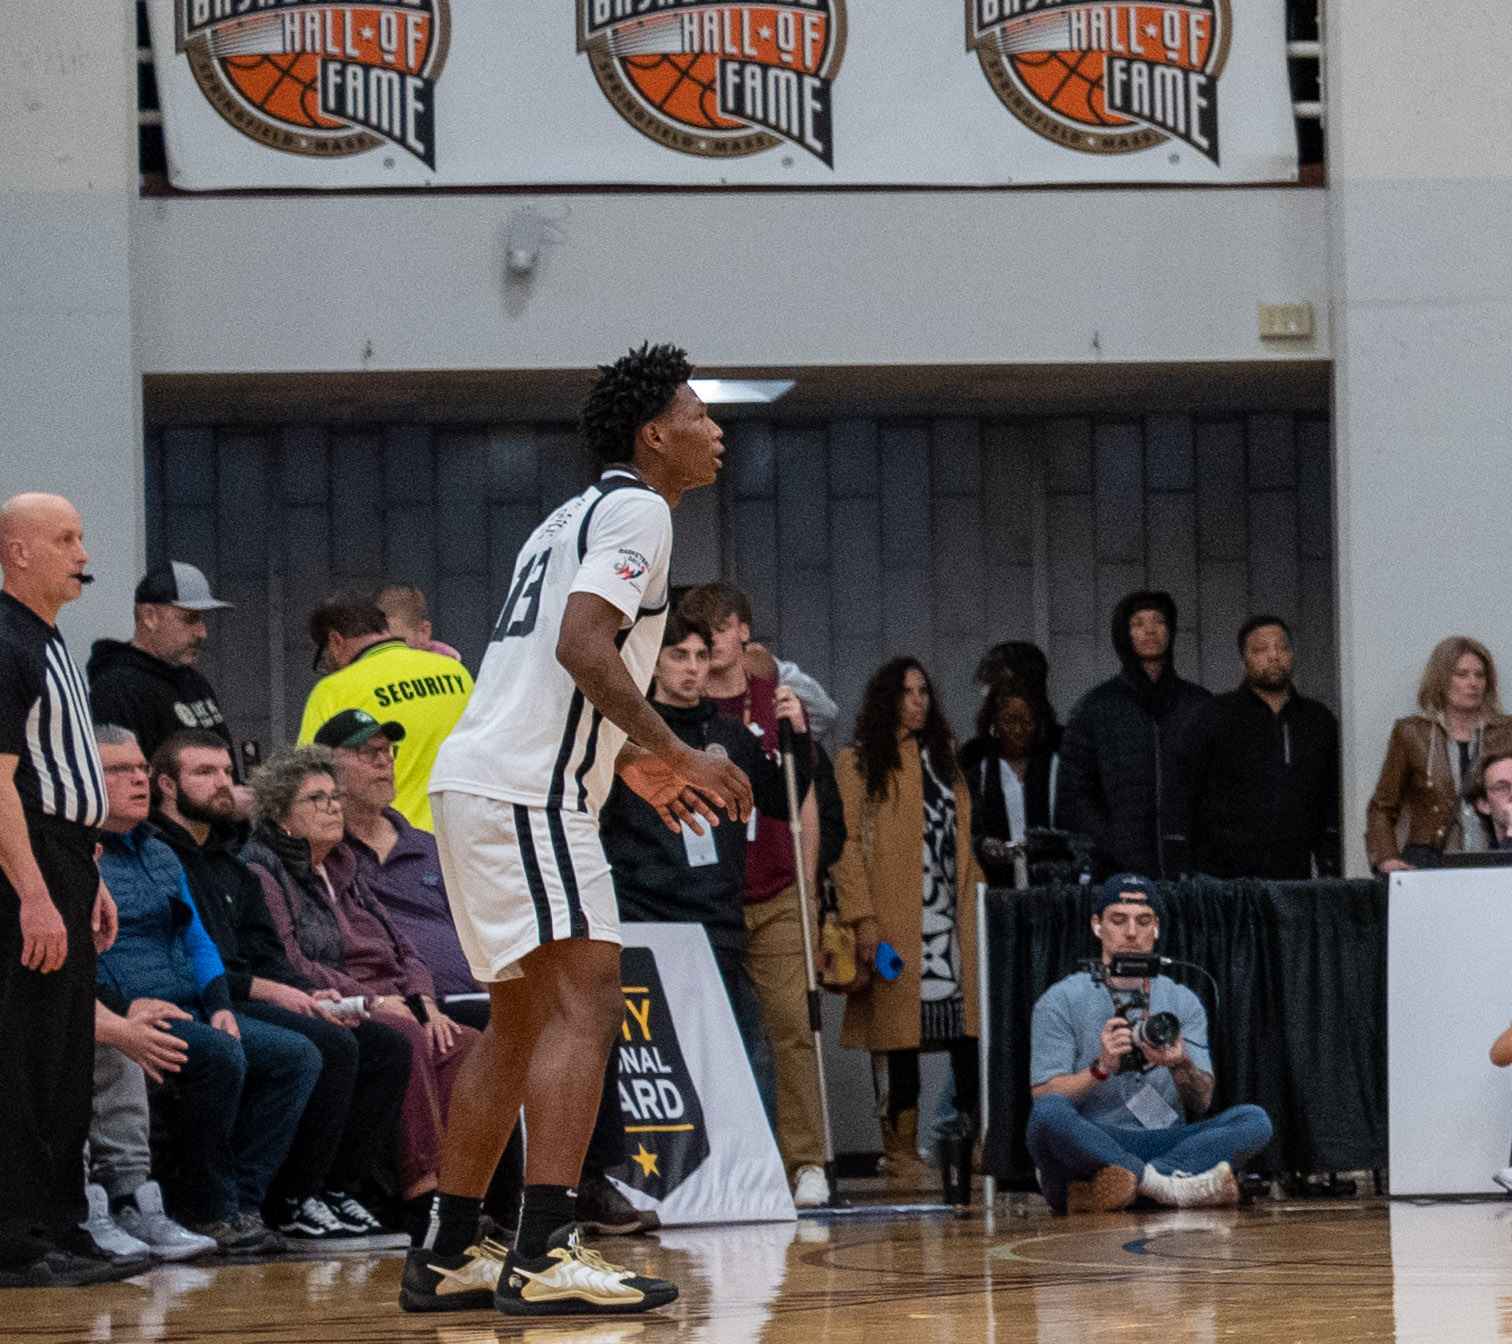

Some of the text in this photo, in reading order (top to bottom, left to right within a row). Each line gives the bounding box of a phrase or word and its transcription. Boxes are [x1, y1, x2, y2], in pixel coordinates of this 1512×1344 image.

[283, 9, 423, 69] HALL OF
[683, 9, 821, 69] HALL OF
[1069, 8, 1205, 67] HALL OF
[327, 61, 426, 156] FAME
[725, 61, 824, 154] FAME
[1111, 58, 1211, 151] FAME
[488, 546, 553, 643] 13
[373, 673, 467, 708] SECURITY
[618, 1078, 685, 1120] ARD
